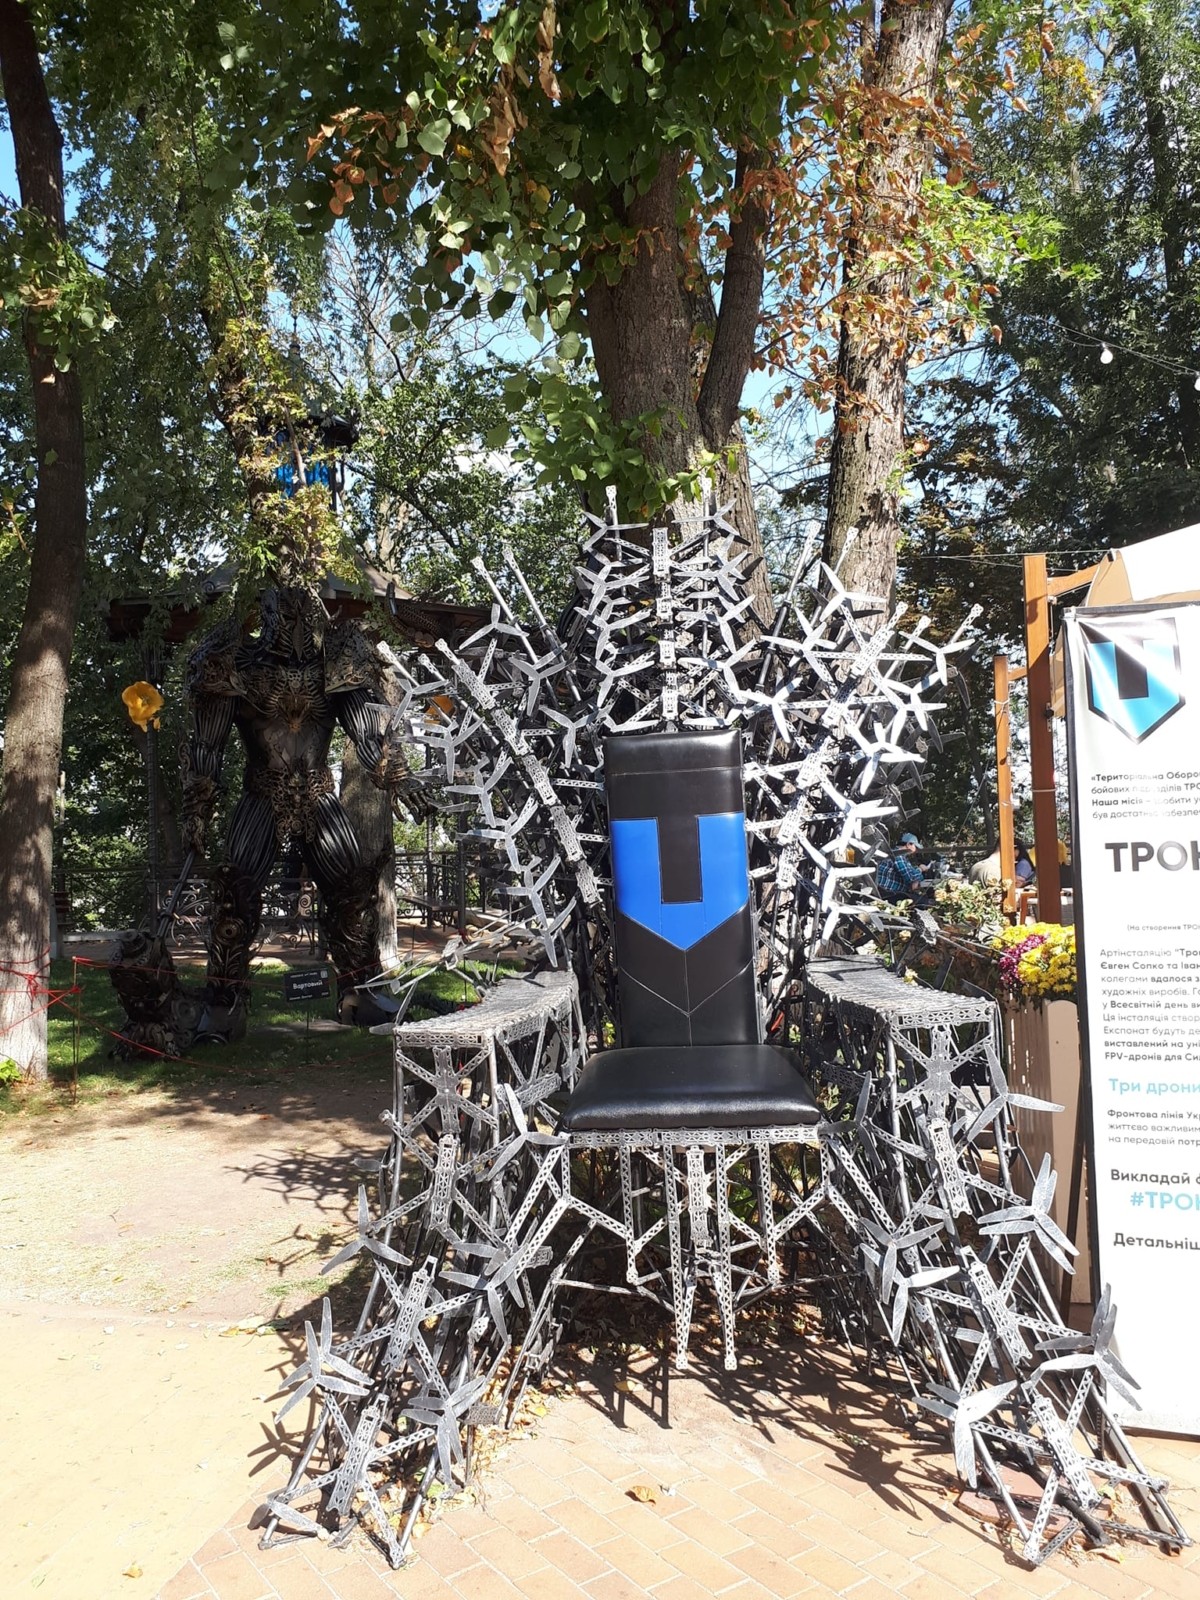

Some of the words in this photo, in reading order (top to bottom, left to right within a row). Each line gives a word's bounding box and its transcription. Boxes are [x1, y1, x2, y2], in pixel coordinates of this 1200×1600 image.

[1166, 771, 1200, 780] Оборо
[1091, 786, 1130, 794] бойових
[1121, 797, 1143, 805] місія
[1092, 811, 1108, 820] був
[1100, 948, 1172, 958] Артінсталяцію
[1100, 961, 1130, 970] Євген
[1132, 961, 1164, 970] Сопко
[1150, 976, 1192, 984] вдалося
[1102, 988, 1146, 997] художніх
[1102, 1002, 1108, 1010] у
[1110, 1000, 1161, 1009] Всесвітній
[1102, 1013, 1115, 1022] Ця
[1118, 1013, 1169, 1022] інсталяція
[1103, 1026, 1150, 1035] Експонат
[1152, 1026, 1186, 1036] будуть
[1104, 1040, 1168, 1048] виставлений
[1104, 1051, 1162, 1062] FPV-дронів
[1164, 1054, 1182, 1062] для
[1185, 1053, 1200, 1061] Си
[1108, 1078, 1141, 1095] Три
[1107, 1109, 1158, 1119] Фронтова
[1160, 1110, 1184, 1119] лінія
[1108, 1123, 1148, 1131] життєво
[1123, 1136, 1175, 1145] передовій
[1111, 1168, 1191, 1186] Викладай
